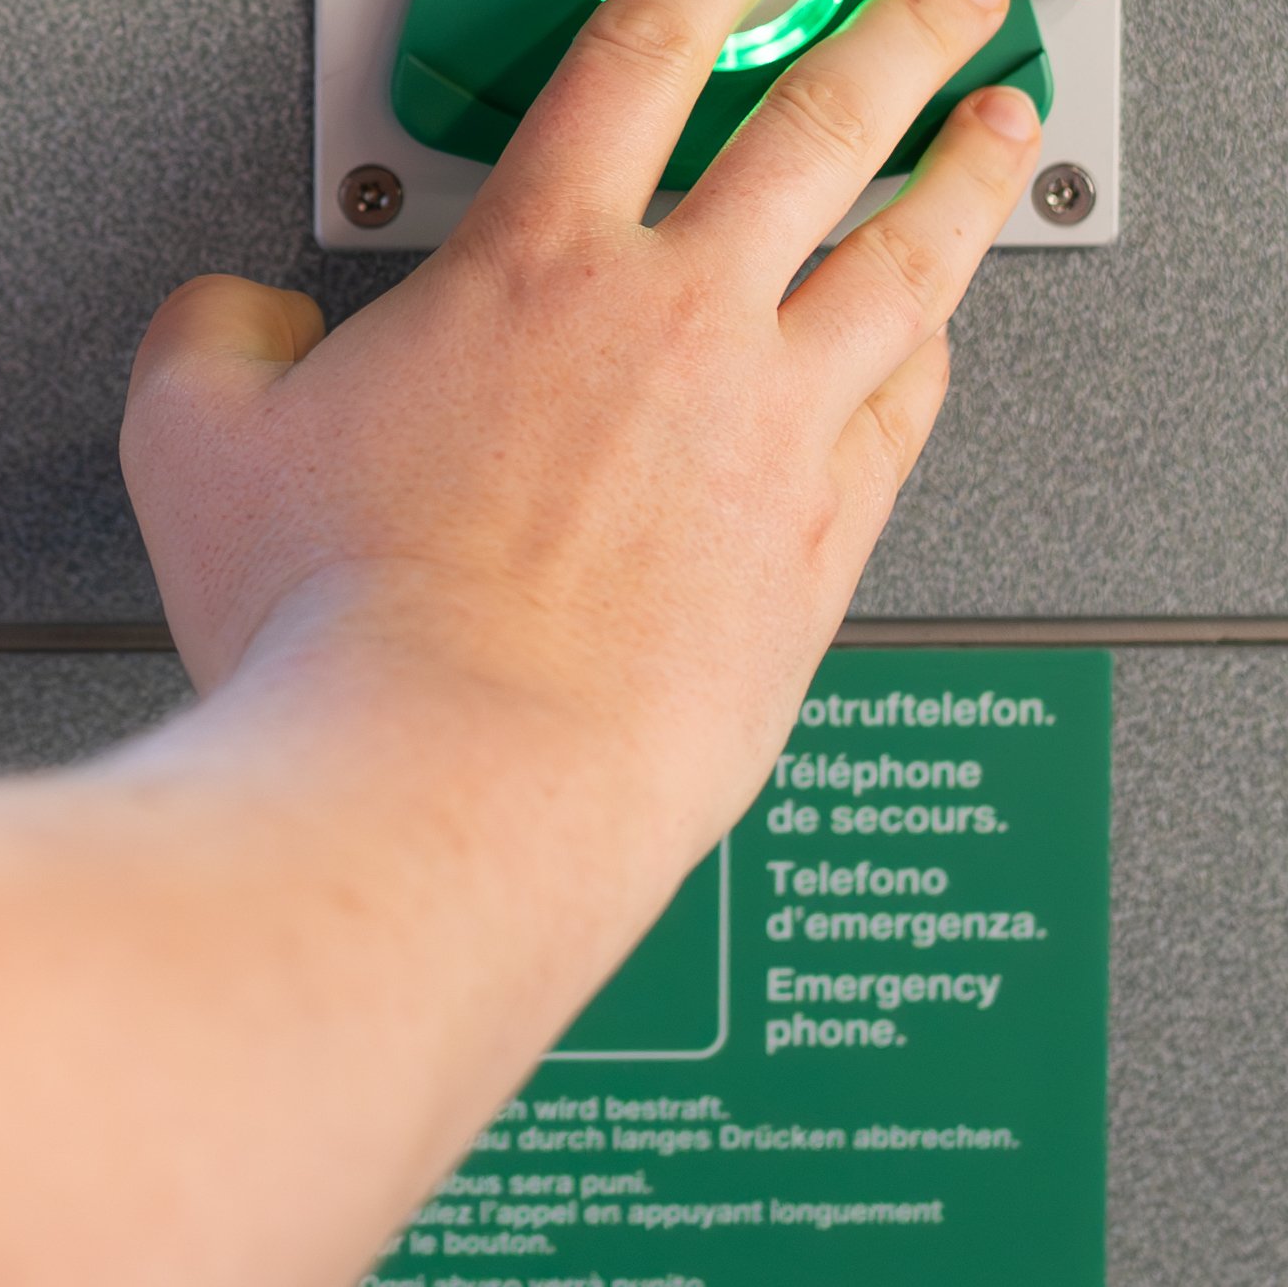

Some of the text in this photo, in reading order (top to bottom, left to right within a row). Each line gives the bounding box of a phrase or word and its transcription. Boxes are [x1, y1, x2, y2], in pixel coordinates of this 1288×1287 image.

[795, 691, 1056, 727] otruftelefon.
[774, 753, 982, 796] Téléphone
[767, 799, 1008, 833] de secours.
[766, 860, 948, 895] Telefono
[766, 906, 1047, 948] d'emergenza.
[767, 967, 1002, 1009] Emergency
[766, 1013, 906, 1055] phone.
[533, 1096, 598, 1120] wird
[605, 1096, 731, 1120] bestraft.
[516, 1127, 604, 1150] durch
[612, 1127, 711, 1156] langes
[719, 1125, 846, 1150] Drücken
[853, 1124, 1020, 1150] abbrechen.
[509, 1175, 574, 1195] sera
[581, 1169, 652, 1200] puni.
[582, 1205, 621, 1225] en
[627, 1203, 763, 1230] appuyant
[770, 1199, 944, 1229] longuement
[409, 1231, 437, 1255] le
[443, 1231, 556, 1255] bouton.
